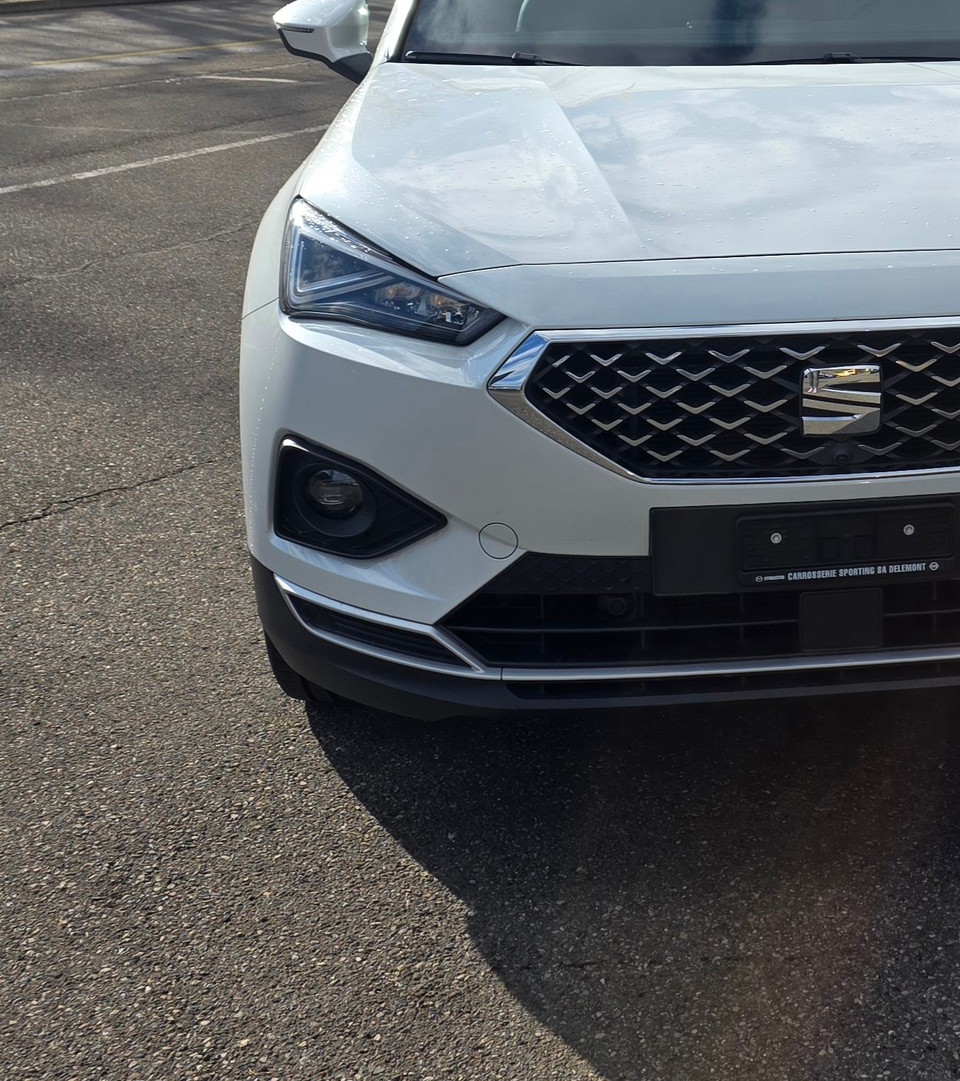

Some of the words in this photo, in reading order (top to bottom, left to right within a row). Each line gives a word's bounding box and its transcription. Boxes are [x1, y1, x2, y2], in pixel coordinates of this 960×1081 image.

[787, 569, 837, 581] CARROSSERIE
[839, 567, 875, 577] SPORTING
[877, 565, 887, 574] SA
[888, 562, 927, 573] DELEMONT
